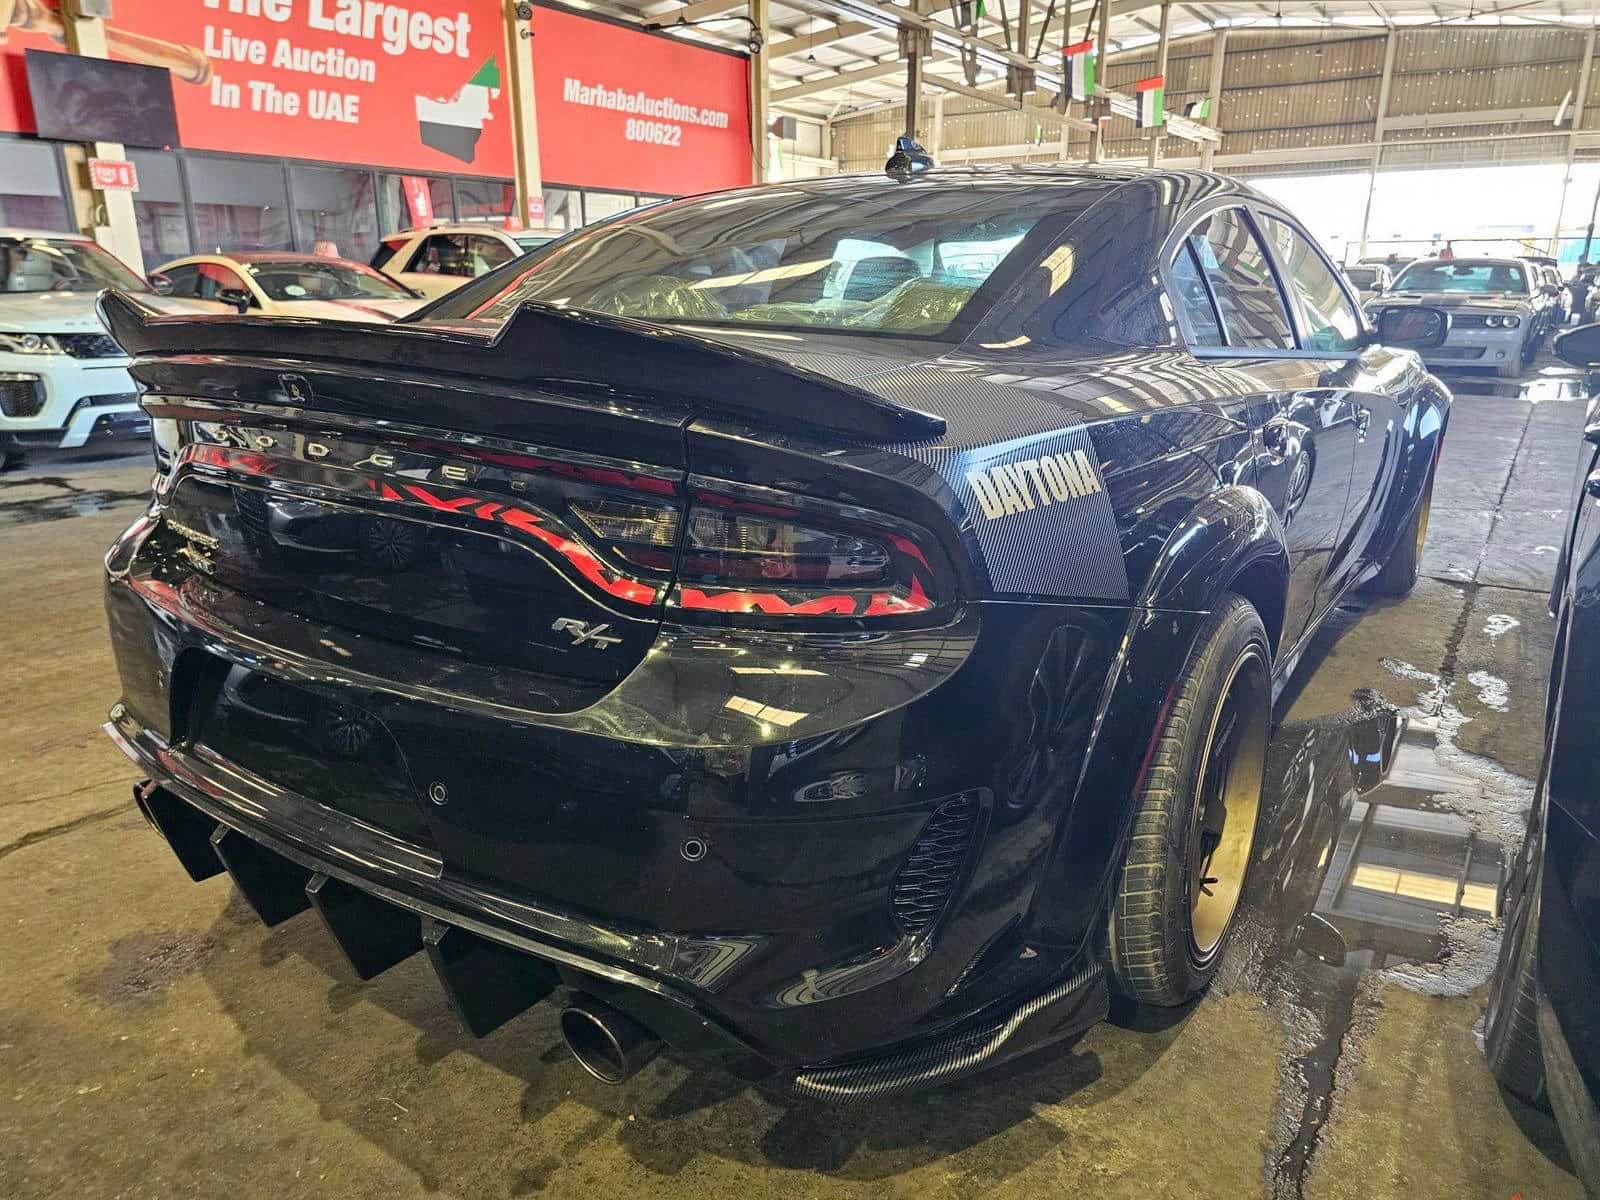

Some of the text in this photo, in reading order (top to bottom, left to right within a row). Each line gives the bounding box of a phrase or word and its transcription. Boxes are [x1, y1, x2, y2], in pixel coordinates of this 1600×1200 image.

[203, 25, 376, 83] Live Auction
[309, 0, 471, 58] Largest
[209, 75, 360, 124] In The UAE
[563, 77, 729, 129] MarhabaAuctions.com
[625, 118, 682, 147] 800622
[965, 449, 1102, 521] DAYTONA
